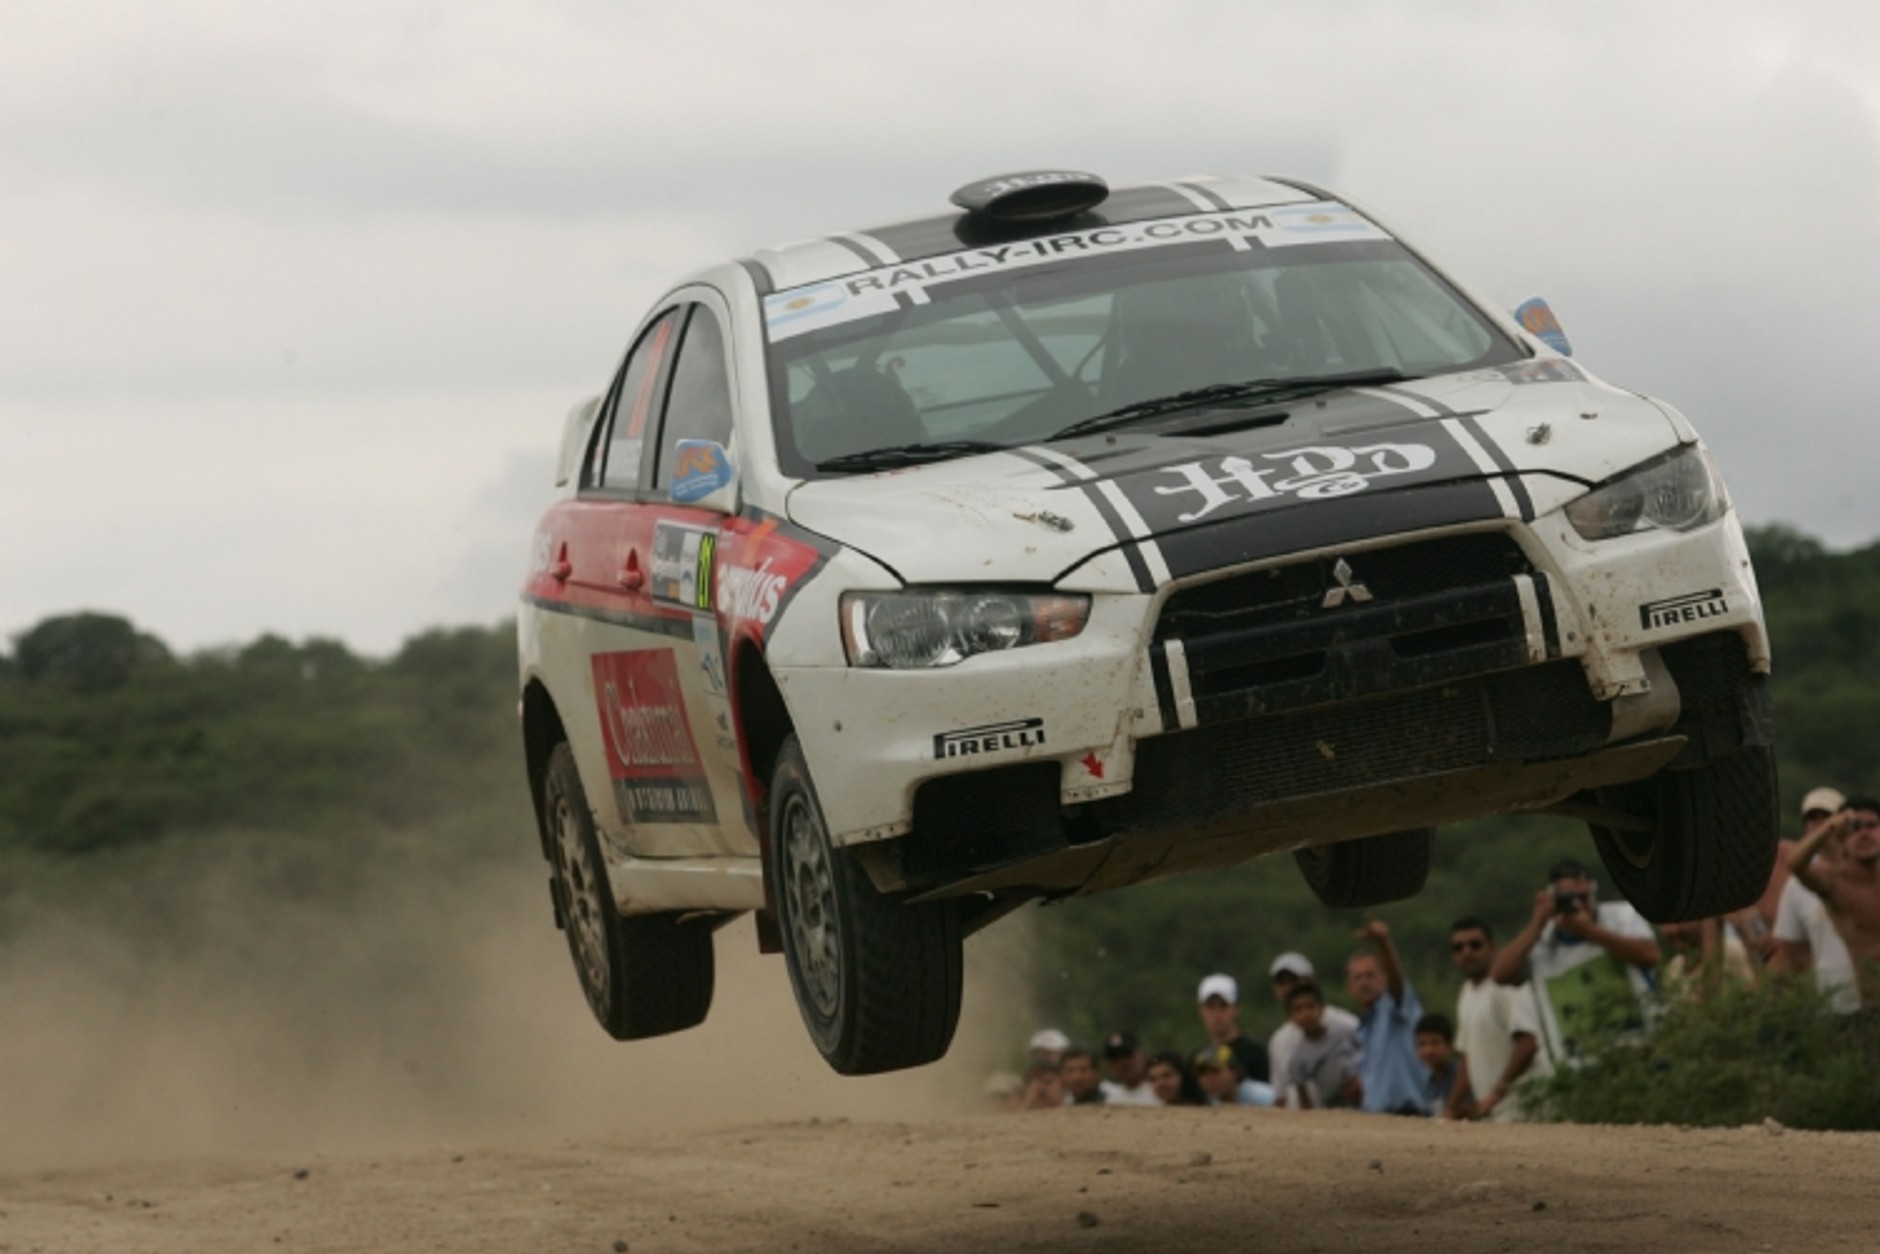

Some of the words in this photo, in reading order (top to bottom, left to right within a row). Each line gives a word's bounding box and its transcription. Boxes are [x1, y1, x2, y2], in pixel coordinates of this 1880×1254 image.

[846, 215, 1274, 295] RALLY-IRC.COM
[1639, 588, 1729, 630] PIRELLI
[933, 717, 1046, 760] PIRELLI
